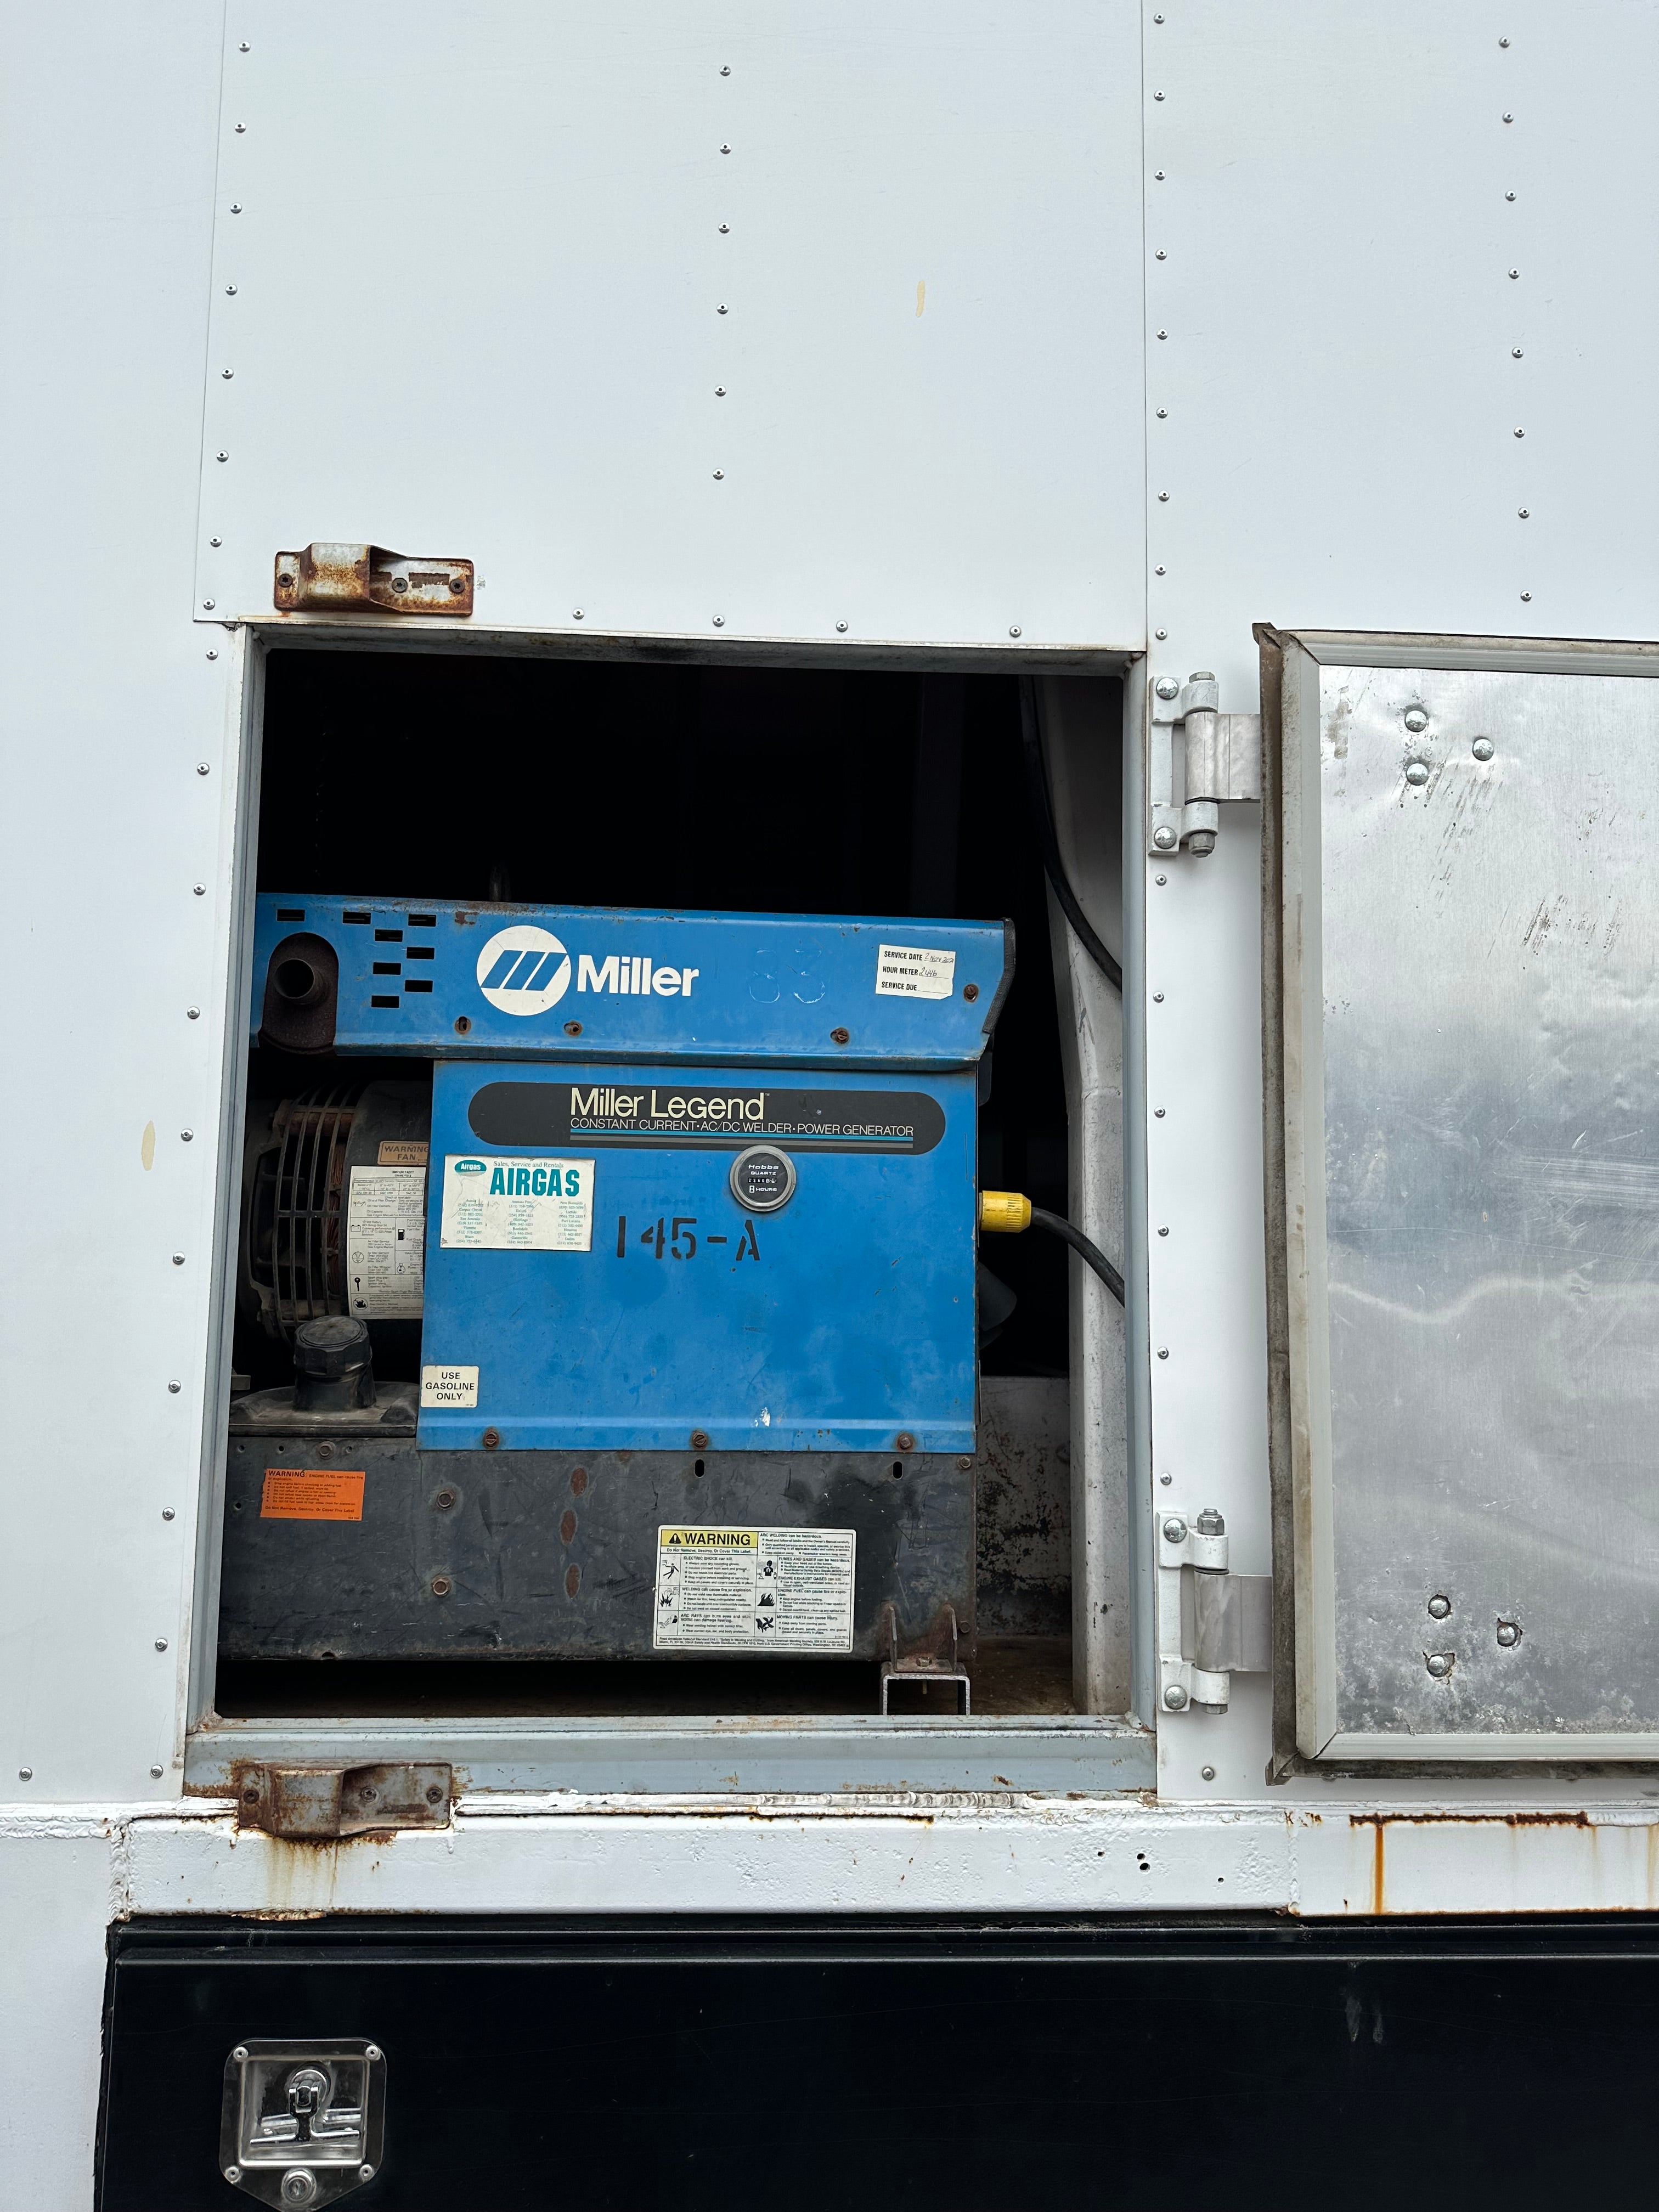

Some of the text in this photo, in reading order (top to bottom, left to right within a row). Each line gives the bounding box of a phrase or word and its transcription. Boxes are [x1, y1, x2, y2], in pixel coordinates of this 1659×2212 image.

[884, 950, 907, 959] SERVICE
[577, 955, 699, 996] Miller
[899, 967, 918, 975] METER
[881, 981, 904, 989] SERVICE
[571, 1087, 644, 1117] Miller
[651, 1090, 764, 1120] Legend
[571, 1118, 636, 1129] CONSTANT
[843, 1125, 913, 1136] GENERATOR
[490, 1167, 579, 1197] AIRGAS
[684, 1532, 750, 1545] WARNING
